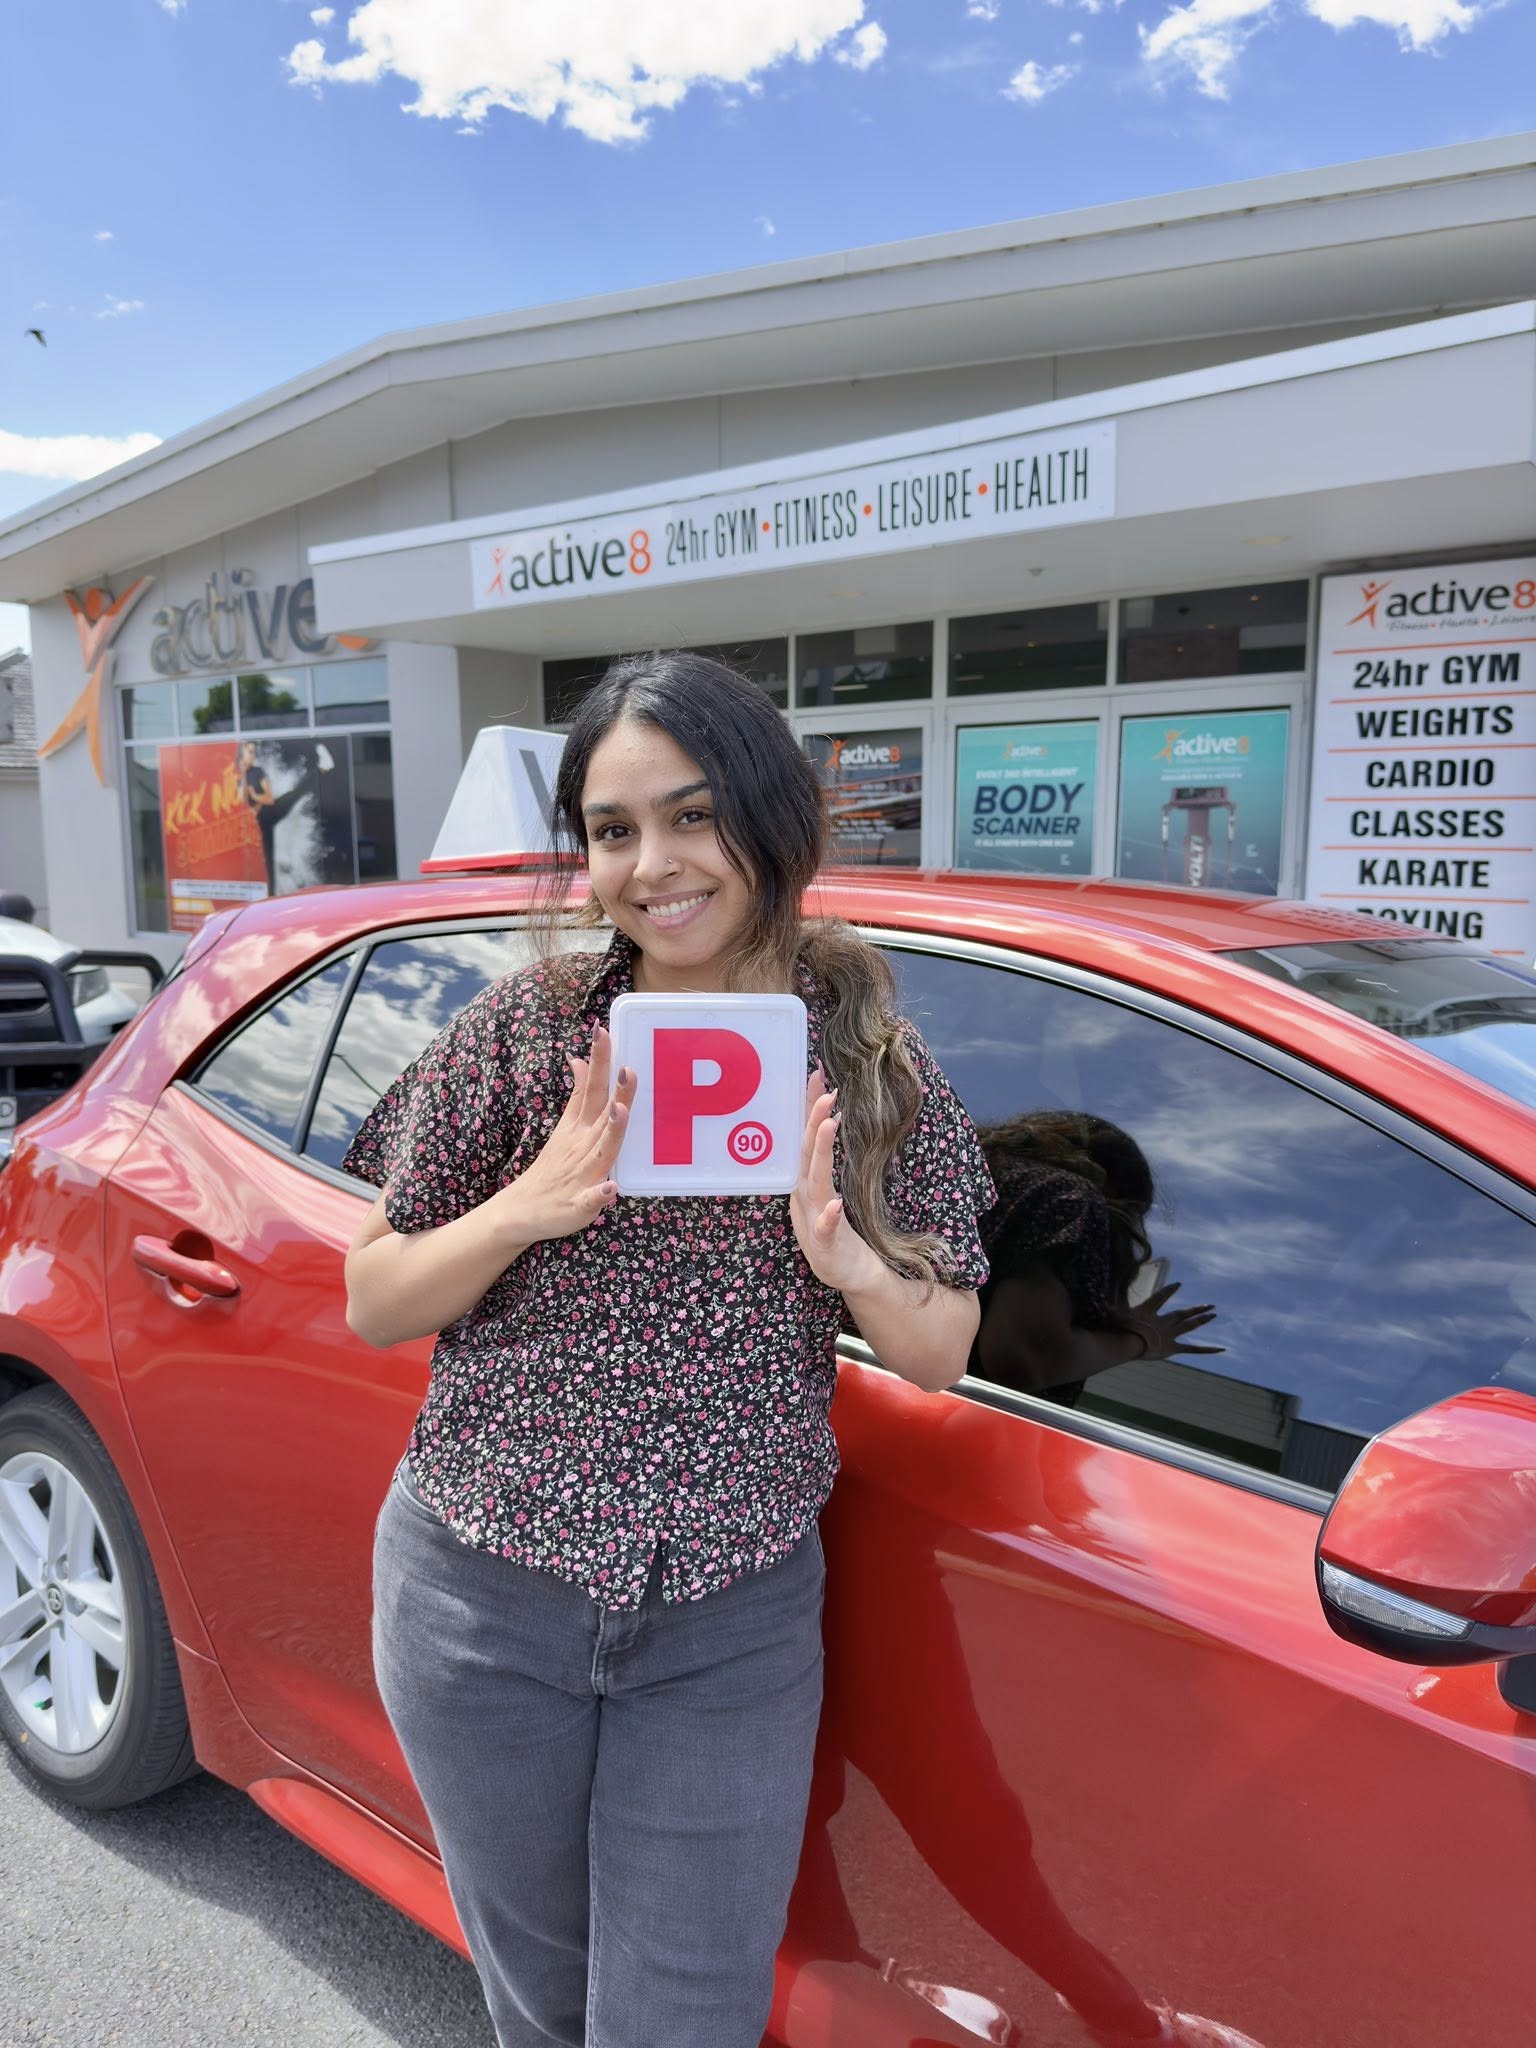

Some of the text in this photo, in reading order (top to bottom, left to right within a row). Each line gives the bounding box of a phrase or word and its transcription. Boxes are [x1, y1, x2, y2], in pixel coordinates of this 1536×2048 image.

[509, 447, 1088, 592] active8 24hr GYM FITNESS LEISURE HEALTH
[1386, 579, 1536, 618] active8
[151, 568, 369, 676] active
[1353, 652, 1520, 689] 24hr GYM
[1356, 705, 1513, 738] WEIGHTS
[840, 744, 901, 765] active8
[1366, 758, 1494, 788] CARDIO
[973, 782, 1085, 815] BODY
[972, 816, 1081, 836] SCANNER
[1351, 810, 1505, 838] CLASSES
[1358, 858, 1490, 888] KARATE
[653, 1028, 761, 1165] P
[737, 1134, 763, 1152] 90
